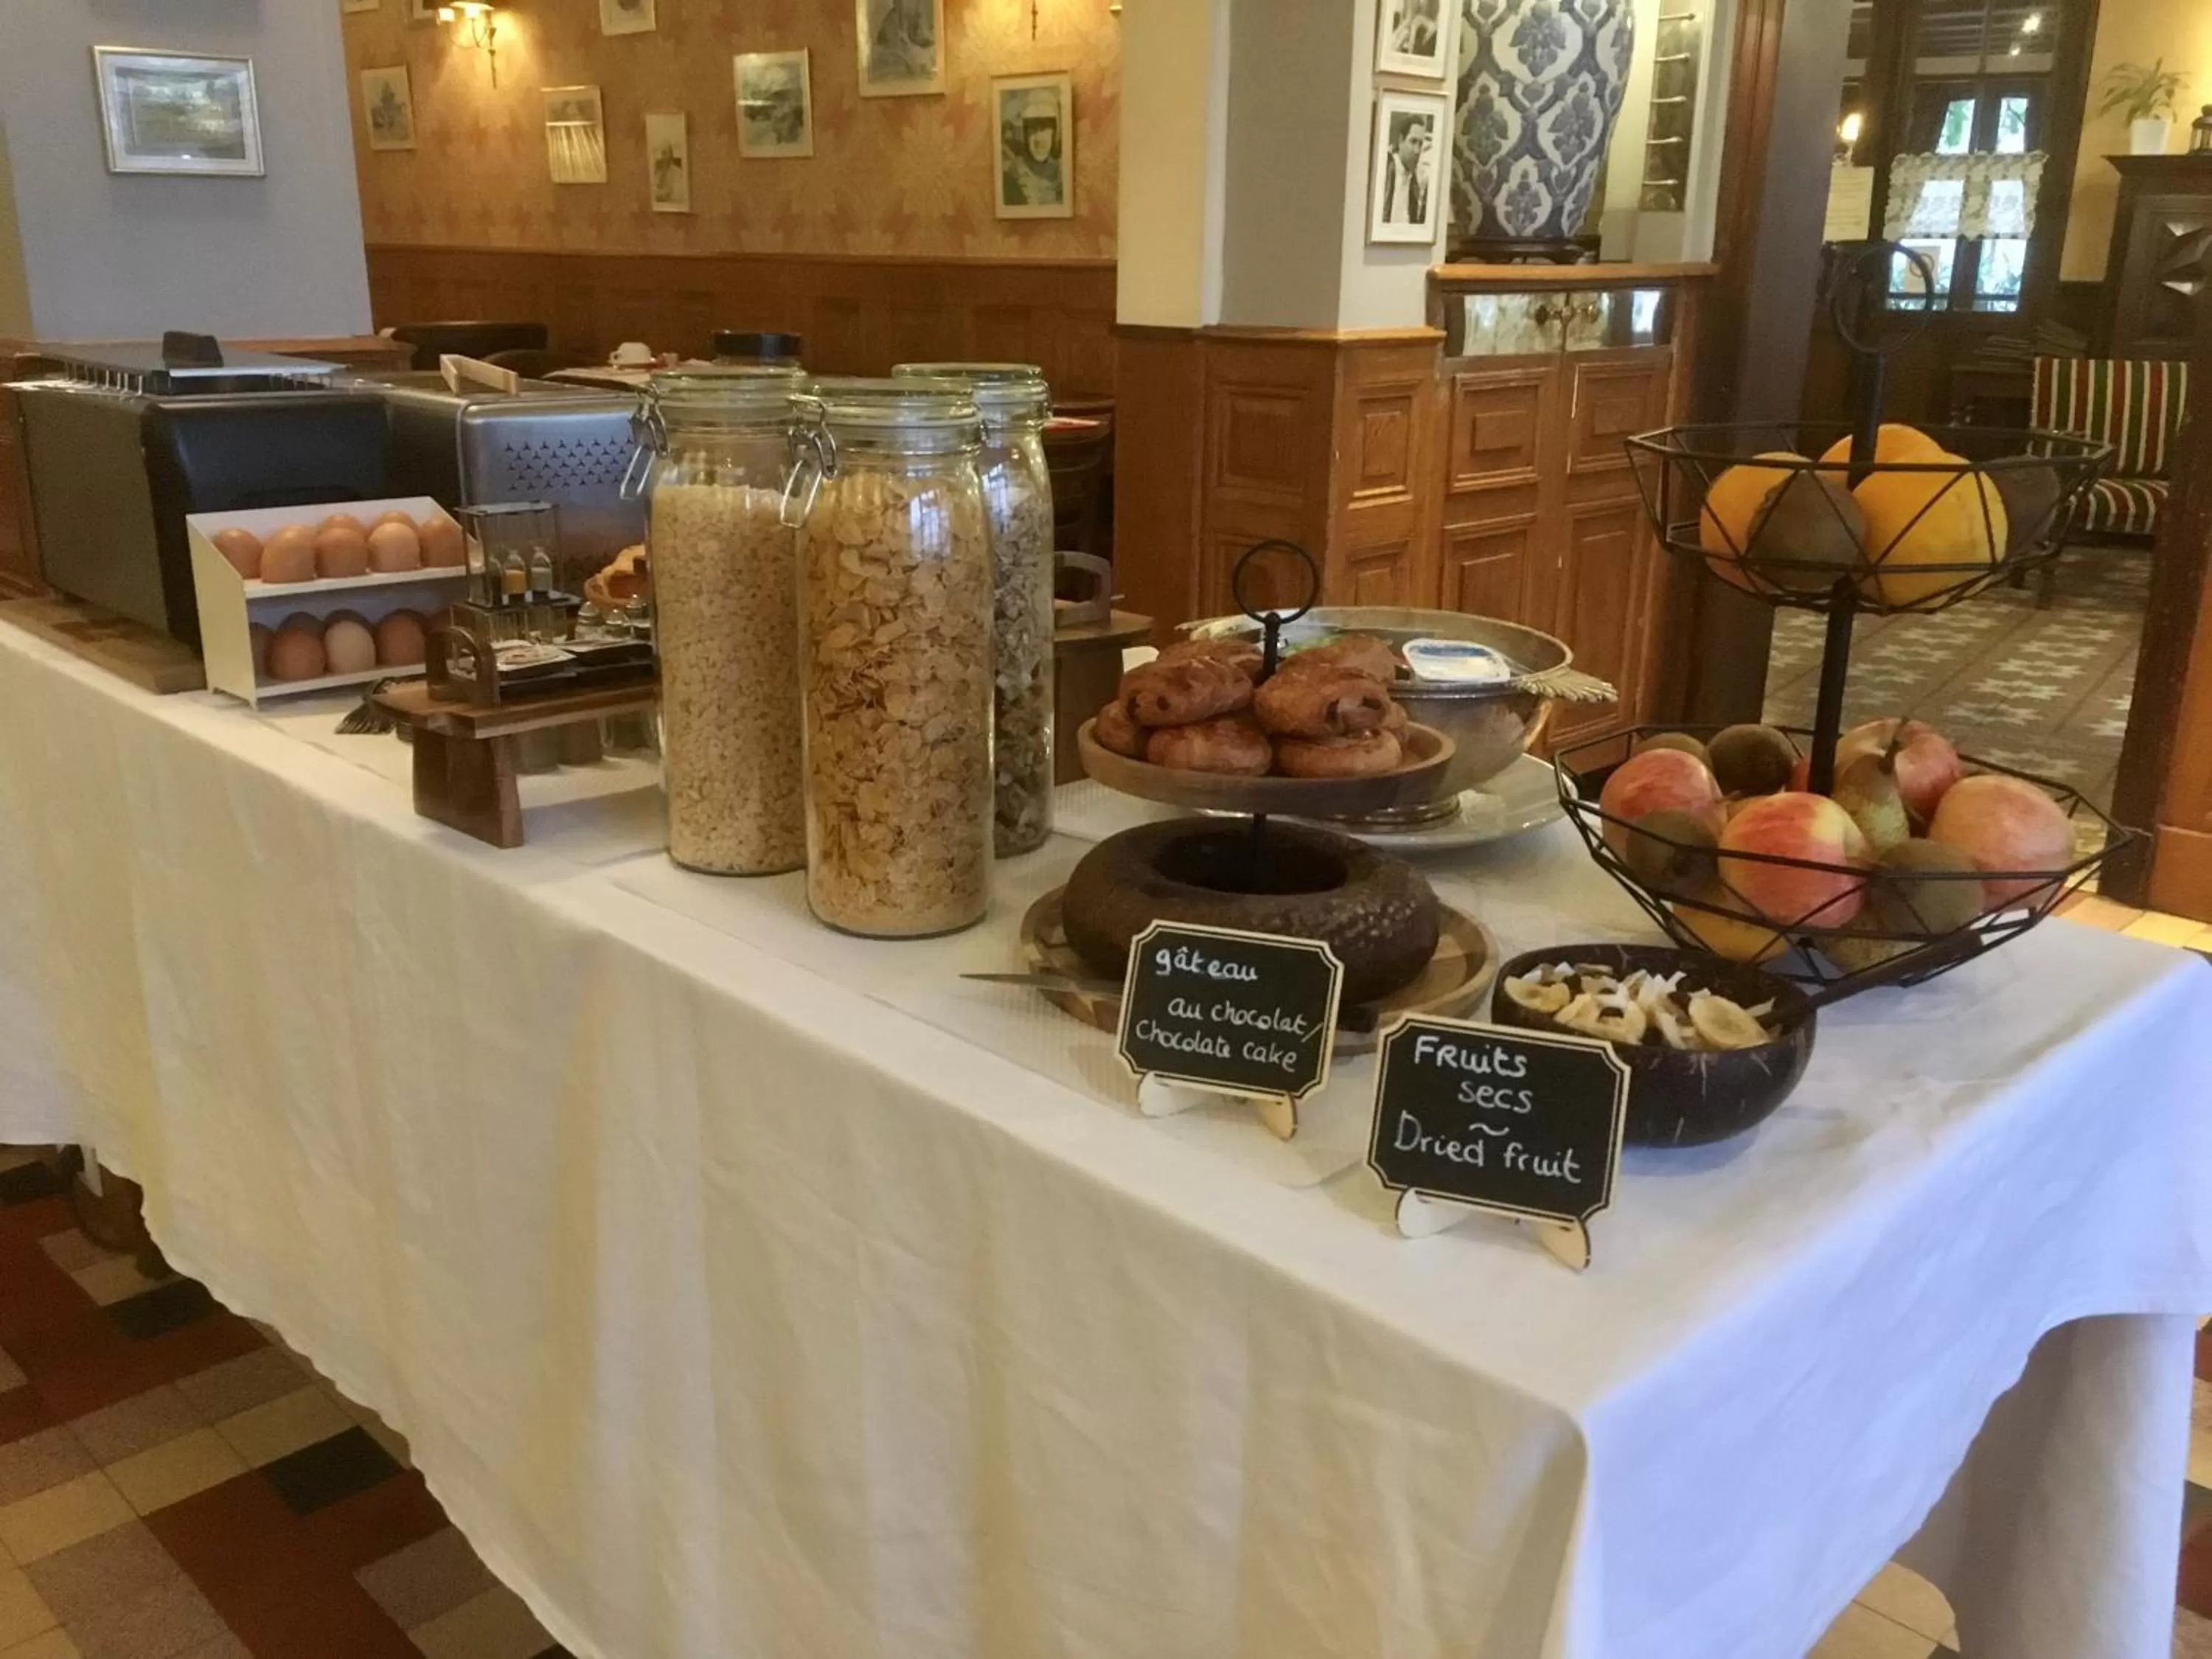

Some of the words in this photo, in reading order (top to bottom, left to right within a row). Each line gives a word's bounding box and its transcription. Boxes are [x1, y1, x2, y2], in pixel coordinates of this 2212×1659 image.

[1155, 946, 1259, 981] gâteau
[1168, 998, 1204, 1021] au
[1457, 1080, 1534, 1114] secs
[1394, 1109, 1484, 1168] Dried
[1503, 1142, 1582, 1184] fruit
